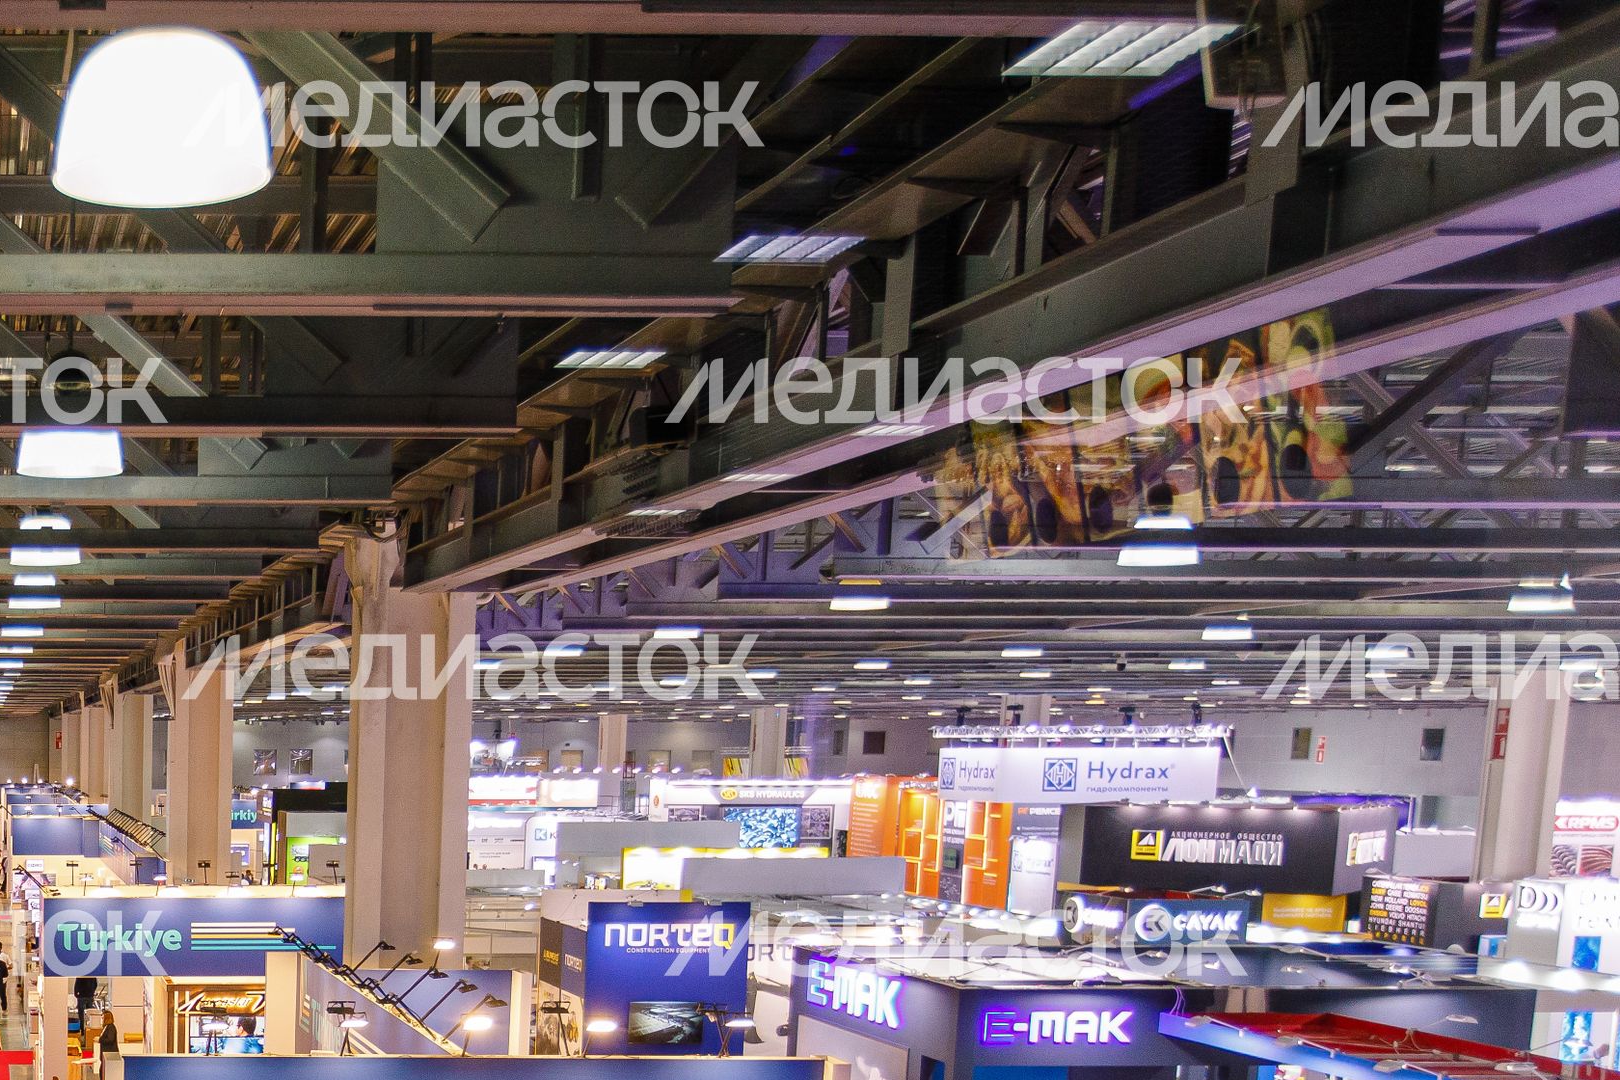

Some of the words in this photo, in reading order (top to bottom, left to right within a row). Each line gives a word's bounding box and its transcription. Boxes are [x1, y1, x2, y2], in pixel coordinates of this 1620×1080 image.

[958, 761, 996, 781] Hydrax
[1087, 761, 1169, 784] Hydrax
[1171, 831, 1230, 839] АКЦИОНЕРНОЕ
[1237, 833, 1283, 841] ОБЩЕСТВО
[56, 922, 182, 957] Türkiye
[807, 958, 903, 1029] E-MAK
[983, 1010, 1132, 1044] E-MAK
